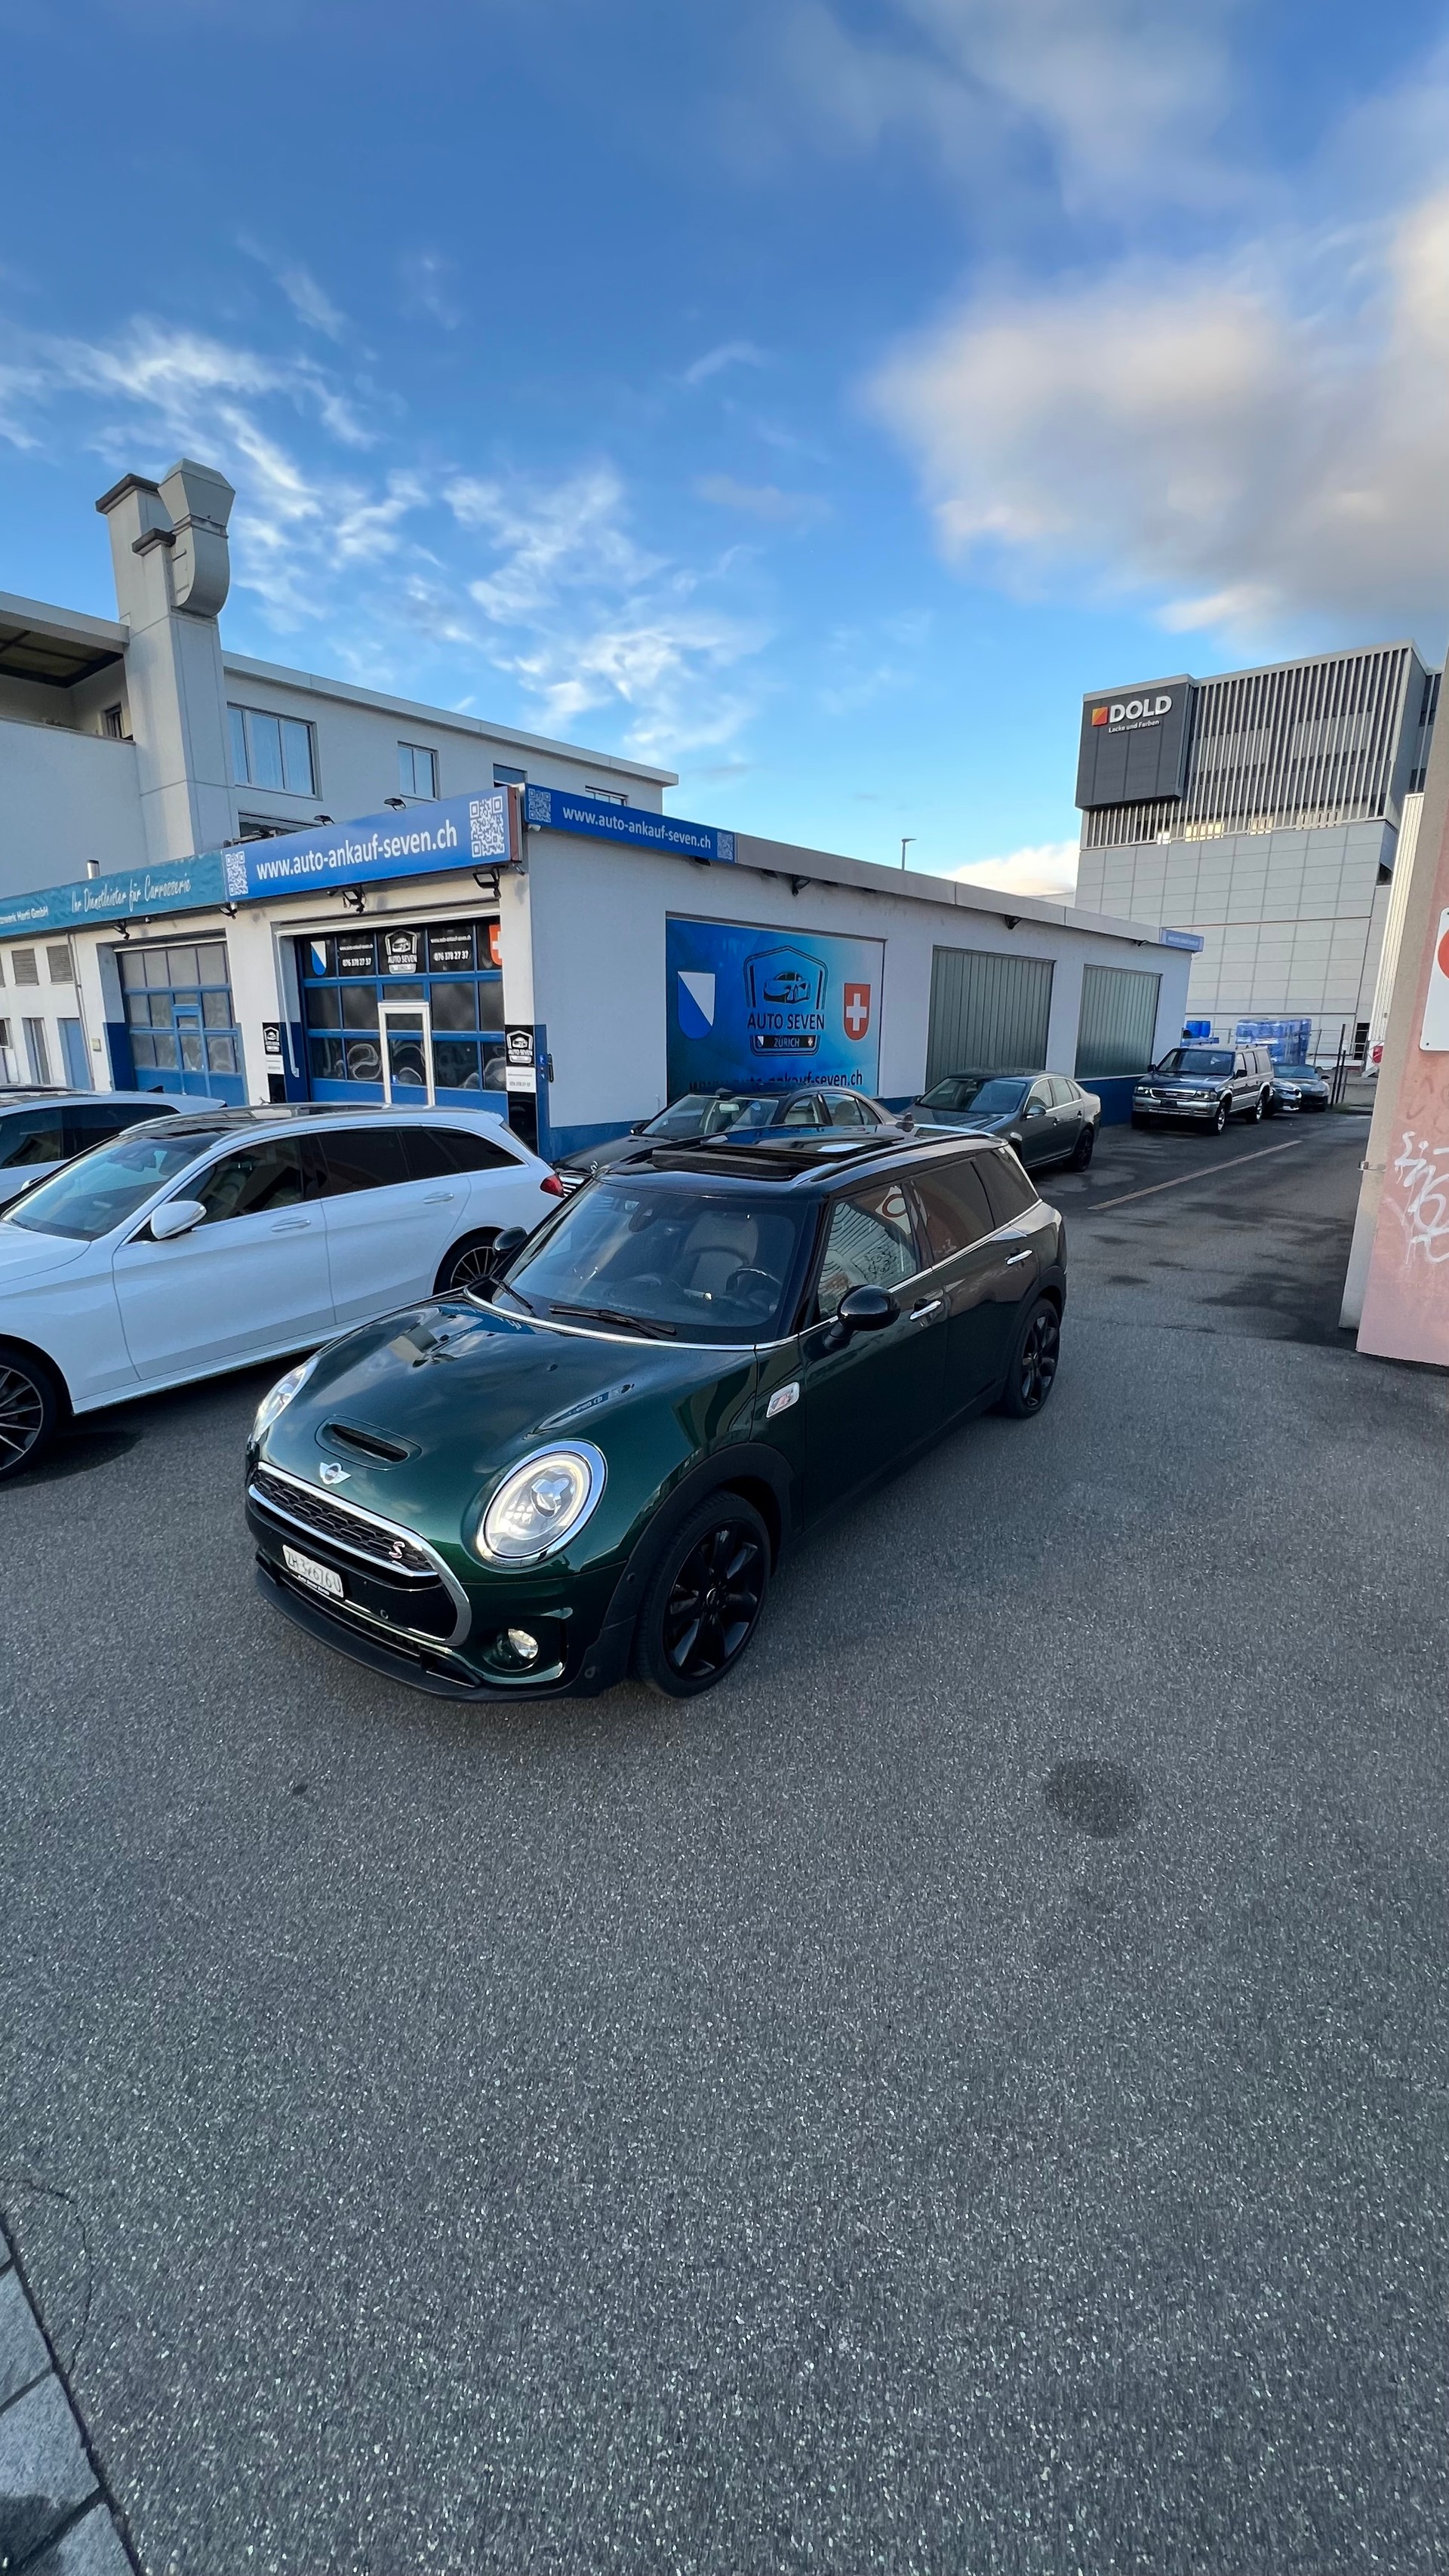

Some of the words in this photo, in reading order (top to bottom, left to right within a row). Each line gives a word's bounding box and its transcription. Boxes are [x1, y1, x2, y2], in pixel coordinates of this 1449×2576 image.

[1109, 695, 1172, 723] DOLD
[1109, 725, 1125, 734] Lacke
[1138, 719, 1160, 728] Farben
[562, 806, 712, 850] www.auto-ankauf-seven.ch
[256, 819, 457, 881] www.auto-ankauf-seven.ch
[129, 879, 141, 912] für
[144, 873, 191, 902] Carrosserie
[388, 956, 401, 964] AUTO
[401, 954, 417, 963] SEVEN
[434, 952, 444, 961] 076
[454, 951, 461, 959] 27
[462, 949, 469, 959] 37
[747, 1013, 783, 1029] AUTO
[787, 1014, 825, 1029] SEVEN
[774, 1036, 800, 1048] ZÜRICH
